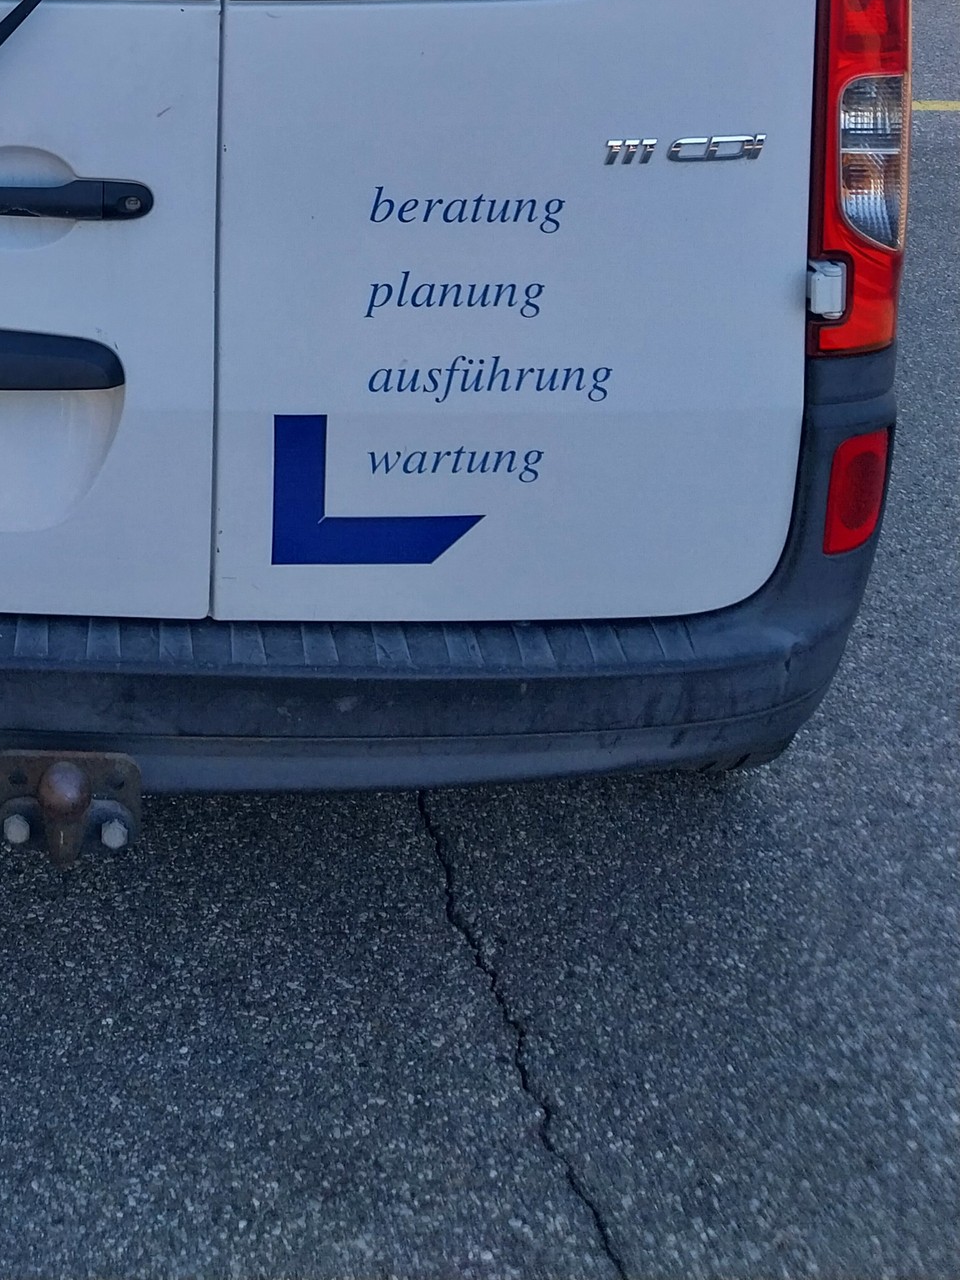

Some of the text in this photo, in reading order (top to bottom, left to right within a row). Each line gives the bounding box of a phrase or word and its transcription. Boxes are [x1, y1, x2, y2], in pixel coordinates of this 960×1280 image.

[604, 134, 767, 165] 111 CDI
[369, 186, 566, 234] beratung
[364, 271, 545, 318] planung
[368, 356, 613, 403] ausführung
[368, 445, 544, 483] wartung
